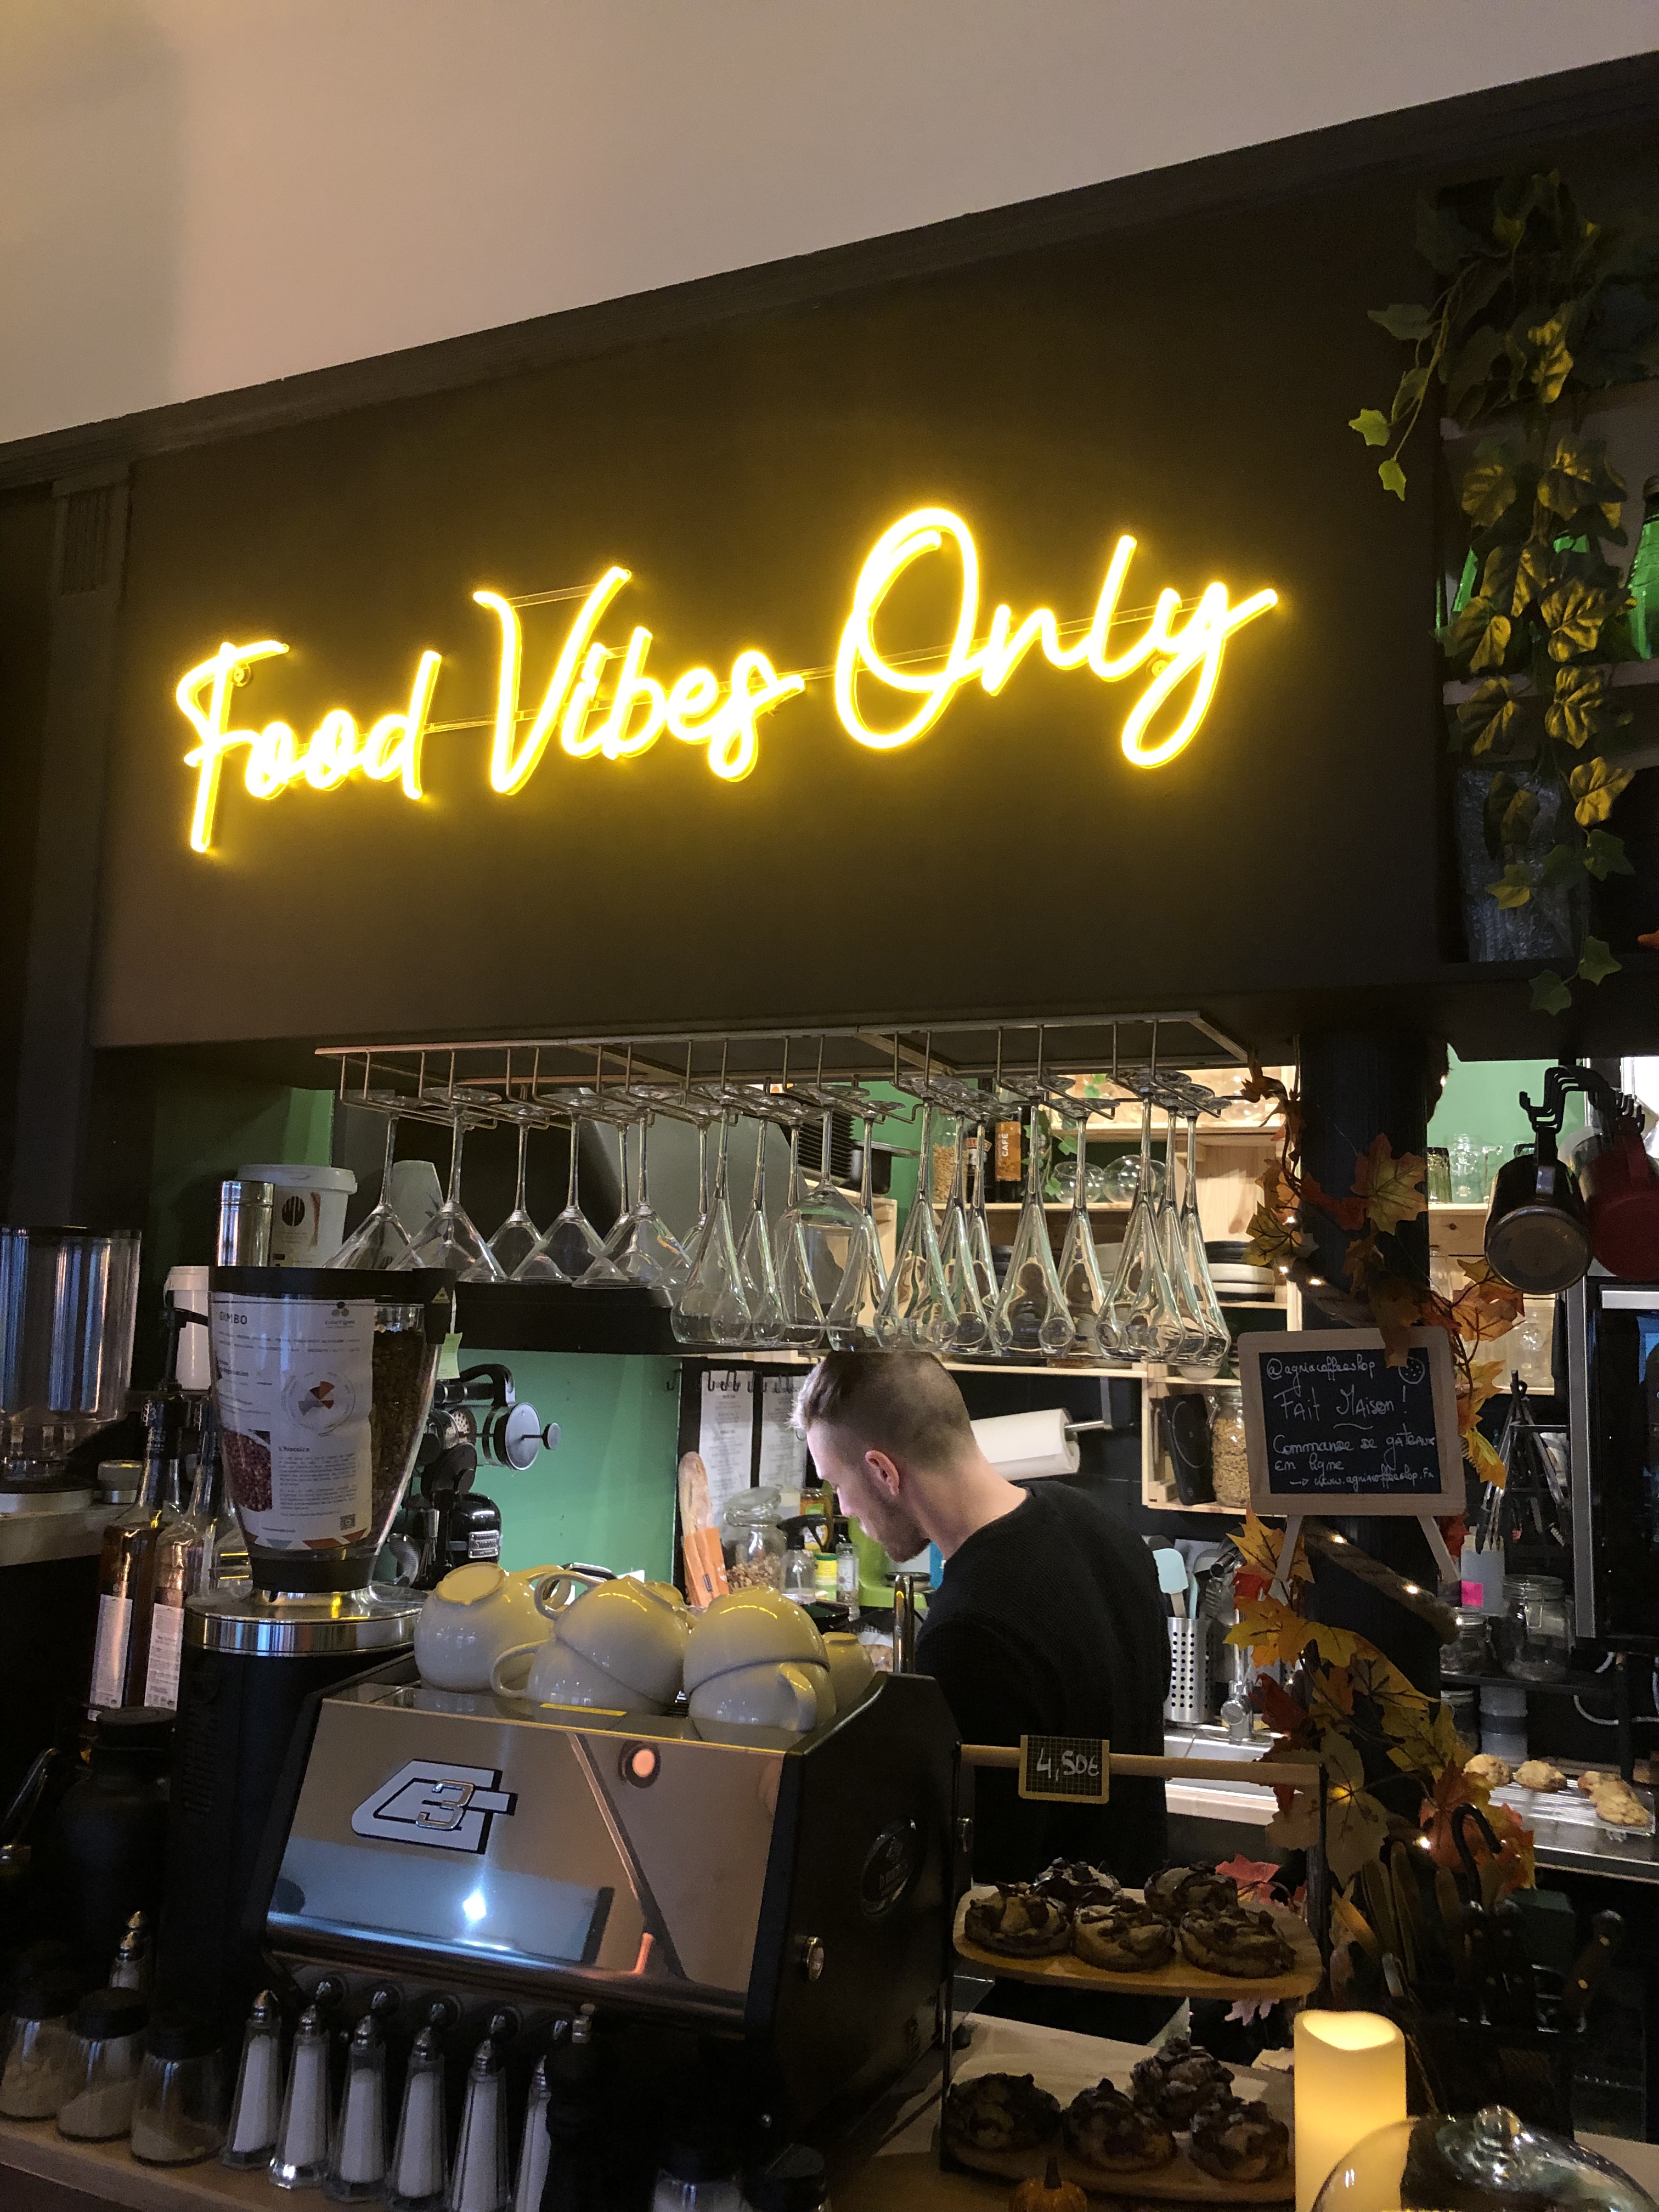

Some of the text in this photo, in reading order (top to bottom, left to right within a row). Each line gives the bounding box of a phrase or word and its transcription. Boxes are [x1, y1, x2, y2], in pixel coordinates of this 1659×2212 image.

[176, 507, 1278, 853] Food Vibes Only
